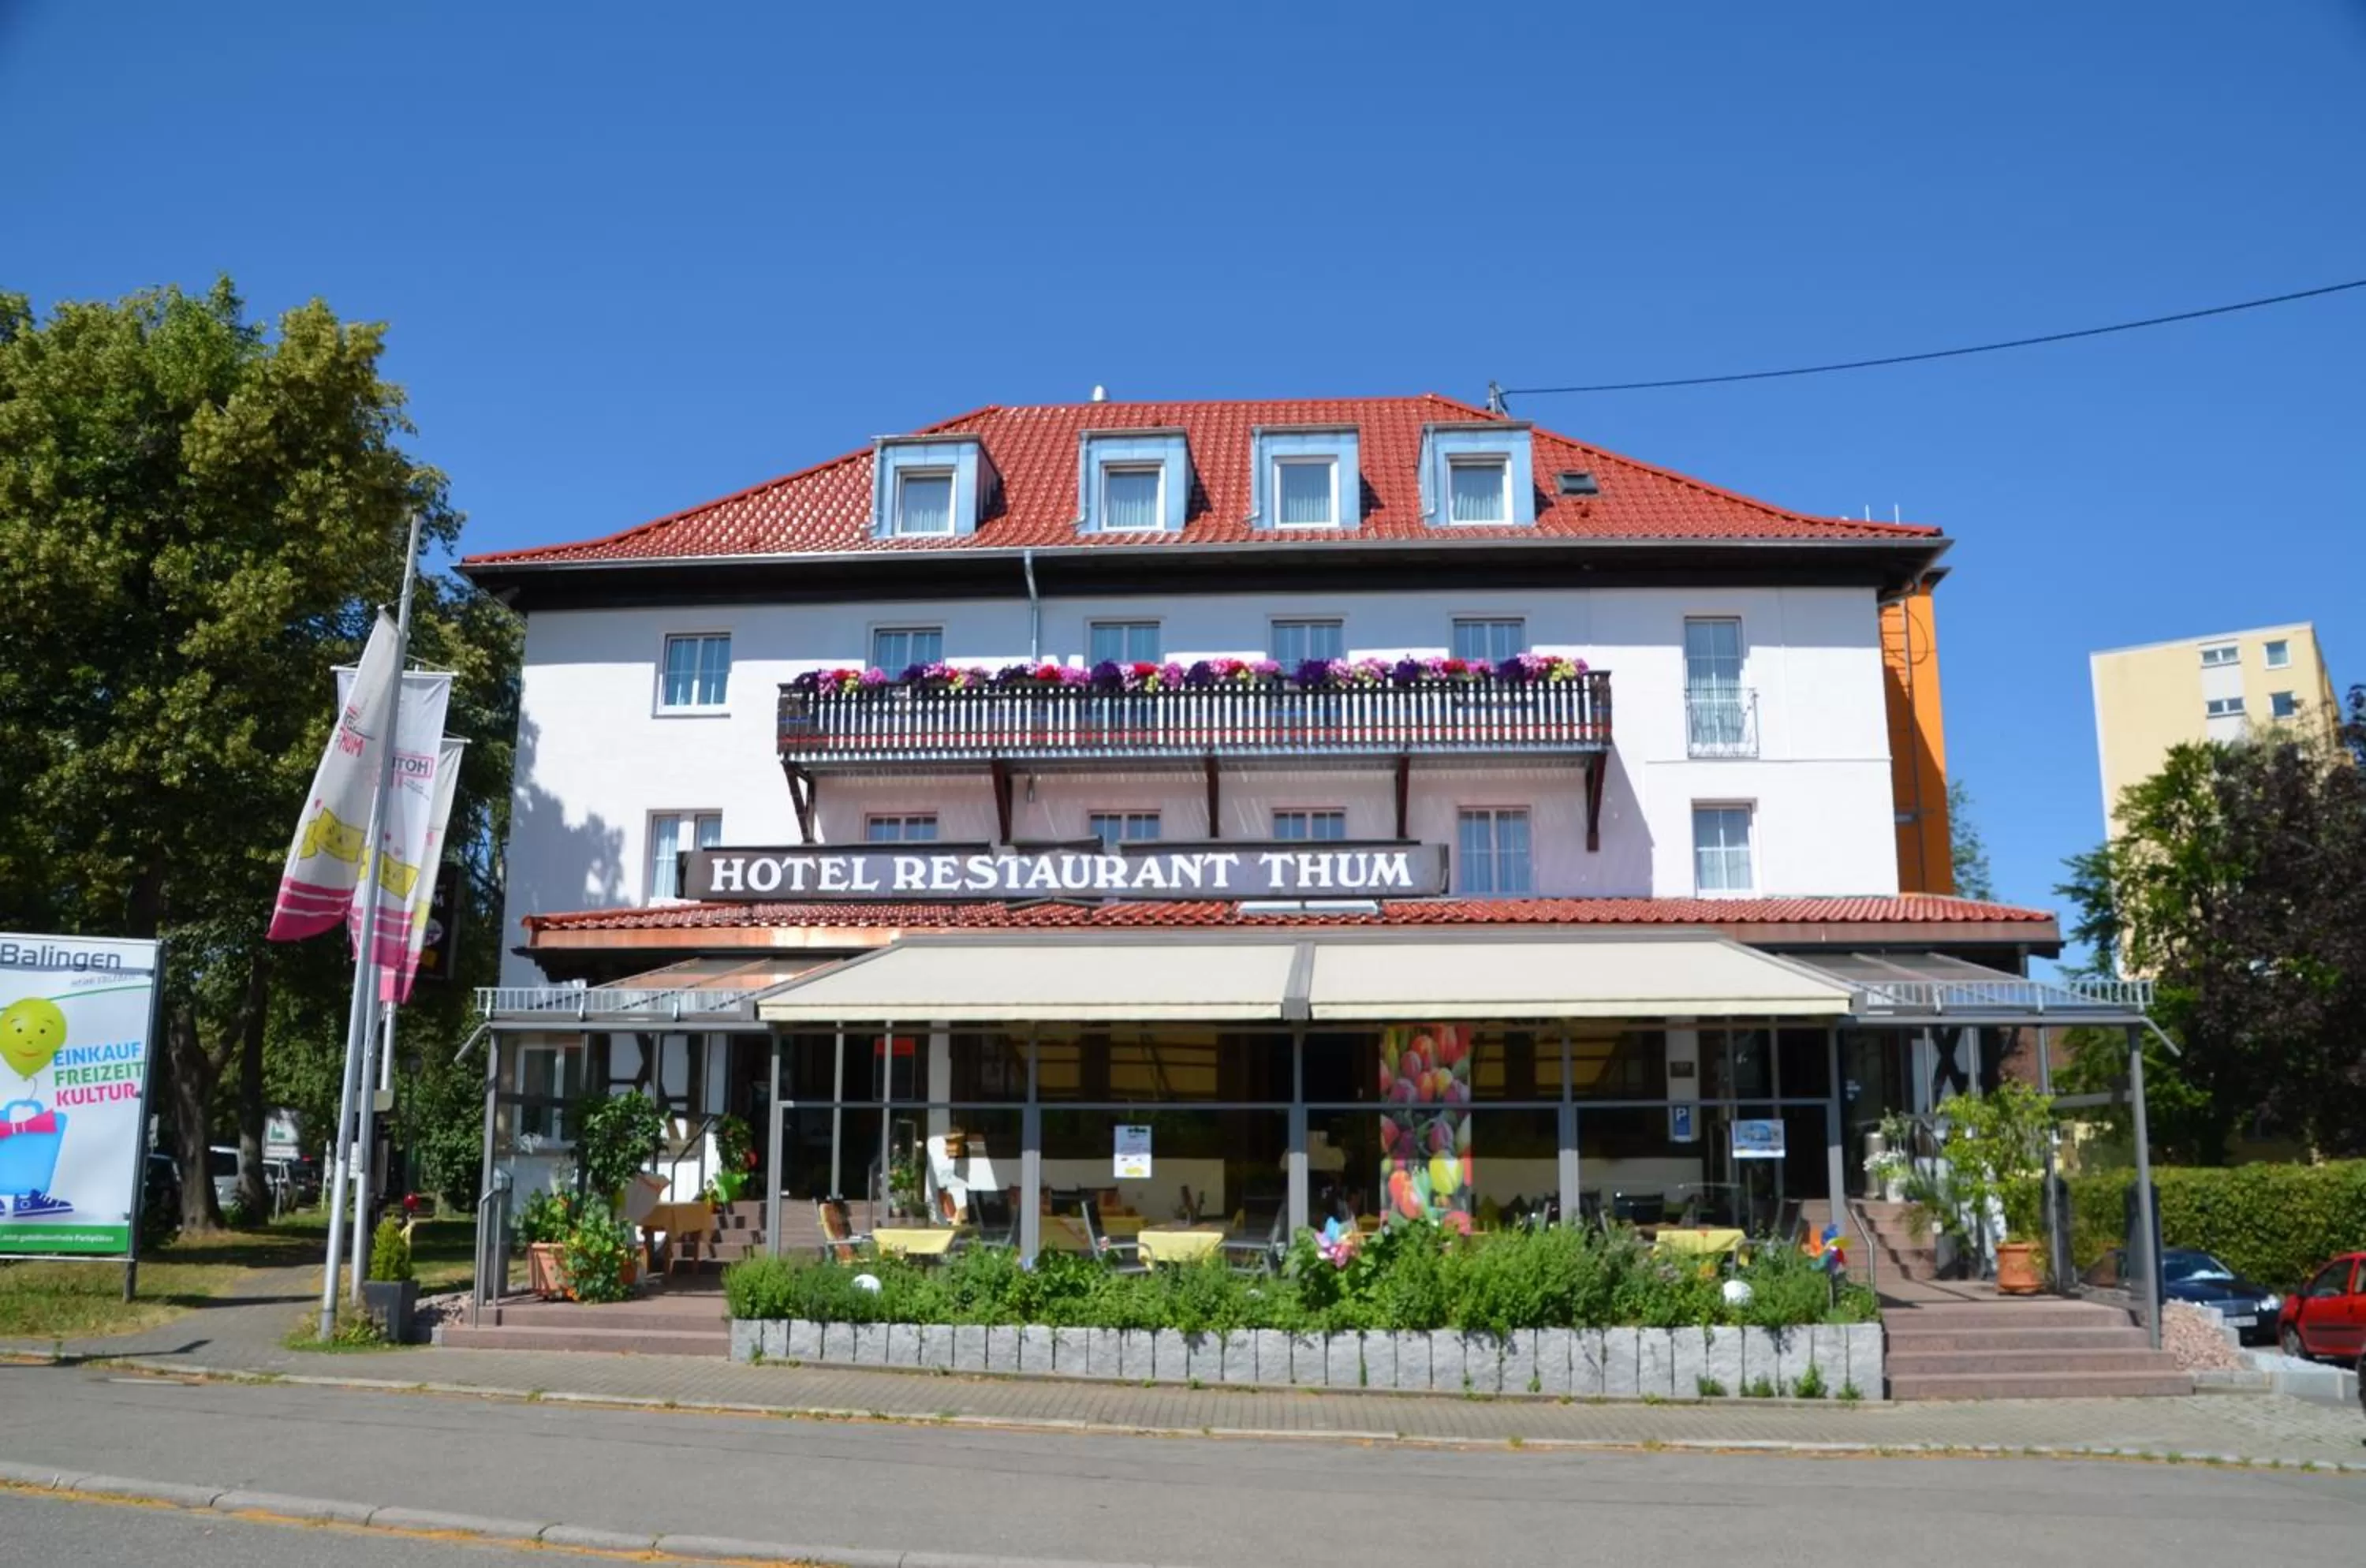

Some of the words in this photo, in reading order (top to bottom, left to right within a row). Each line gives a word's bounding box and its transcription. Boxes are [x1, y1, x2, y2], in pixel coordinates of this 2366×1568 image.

[711, 857, 880, 892] HOTEL
[892, 852, 1240, 891] RESTAURANT
[1260, 851, 1414, 888] THUM
[0, 943, 121, 972] Balingen
[53, 1041, 141, 1067] EINKAUF
[54, 1061, 145, 1087] FREIZEIT
[56, 1082, 138, 1107] KULTUR
[1675, 1107, 1688, 1122] P
